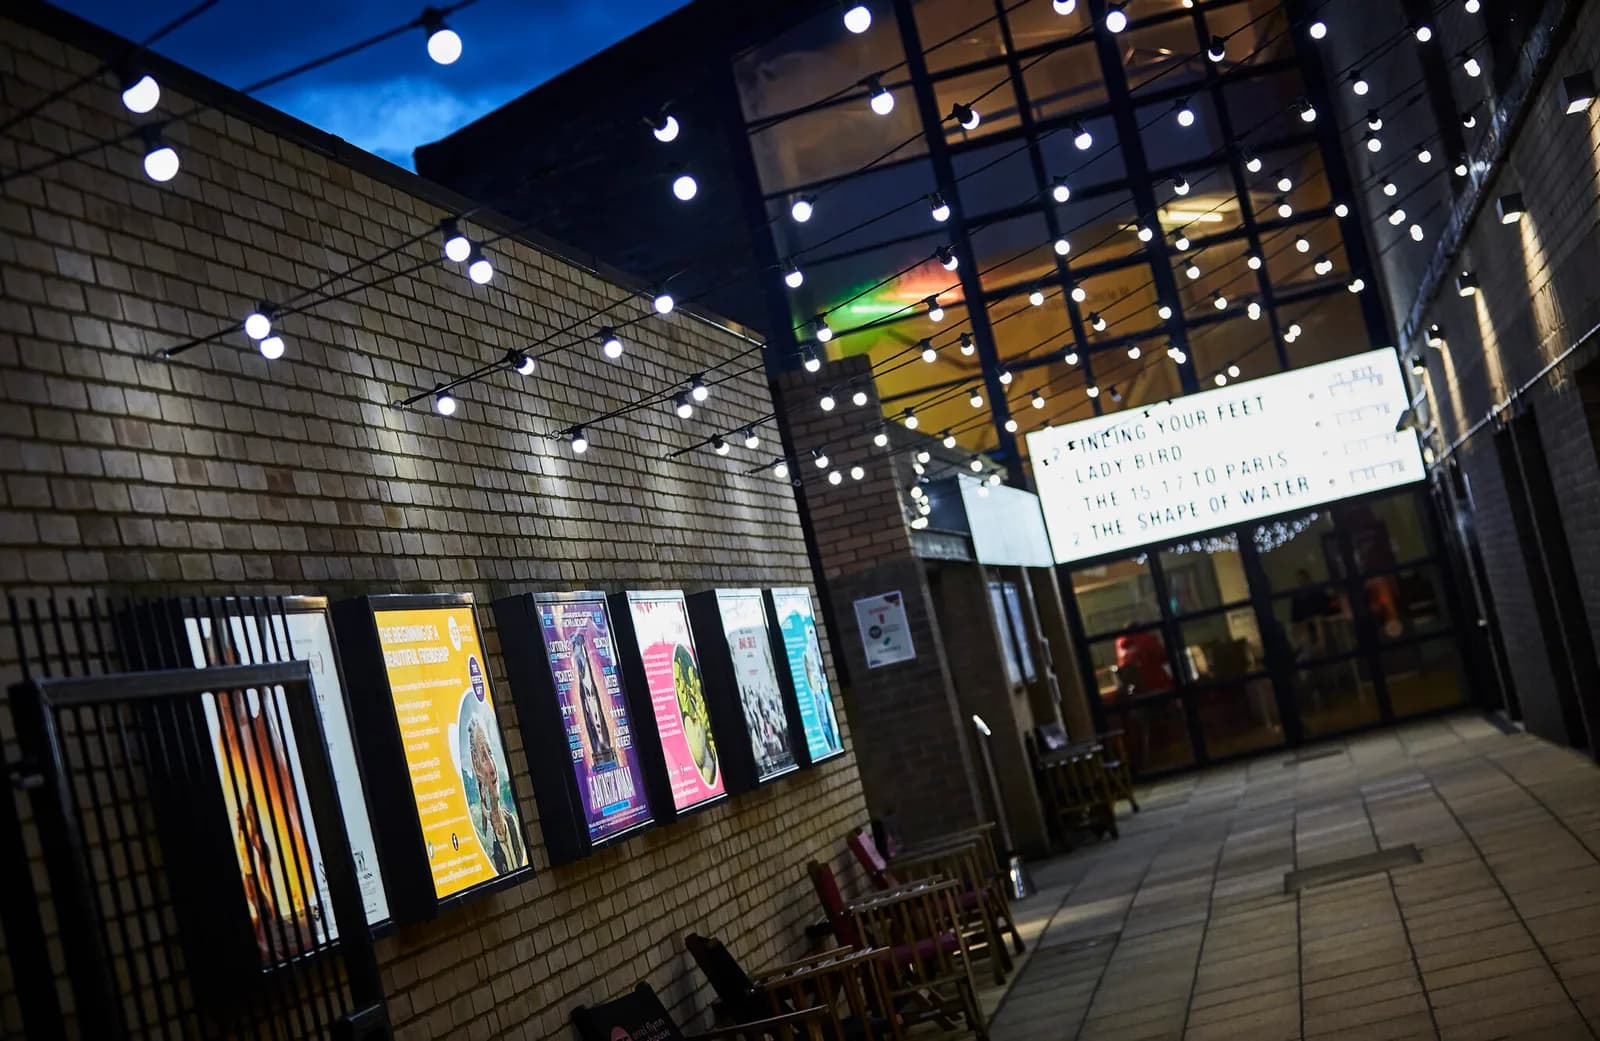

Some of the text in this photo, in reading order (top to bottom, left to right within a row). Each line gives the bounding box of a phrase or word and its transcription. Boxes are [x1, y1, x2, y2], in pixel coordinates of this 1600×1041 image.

[1155, 410, 1208, 434] YOUR
[1216, 395, 1266, 421] FEET
[1075, 444, 1184, 485] LADY BIRD
[1083, 492, 1120, 513] THE
[1192, 467, 1217, 488] TO
[1226, 450, 1289, 480] PARIS
[1089, 520, 1126, 541] THE
[1137, 500, 1201, 530] SHAPE
[1209, 494, 1229, 513] OF
[1239, 476, 1311, 506] WATER
